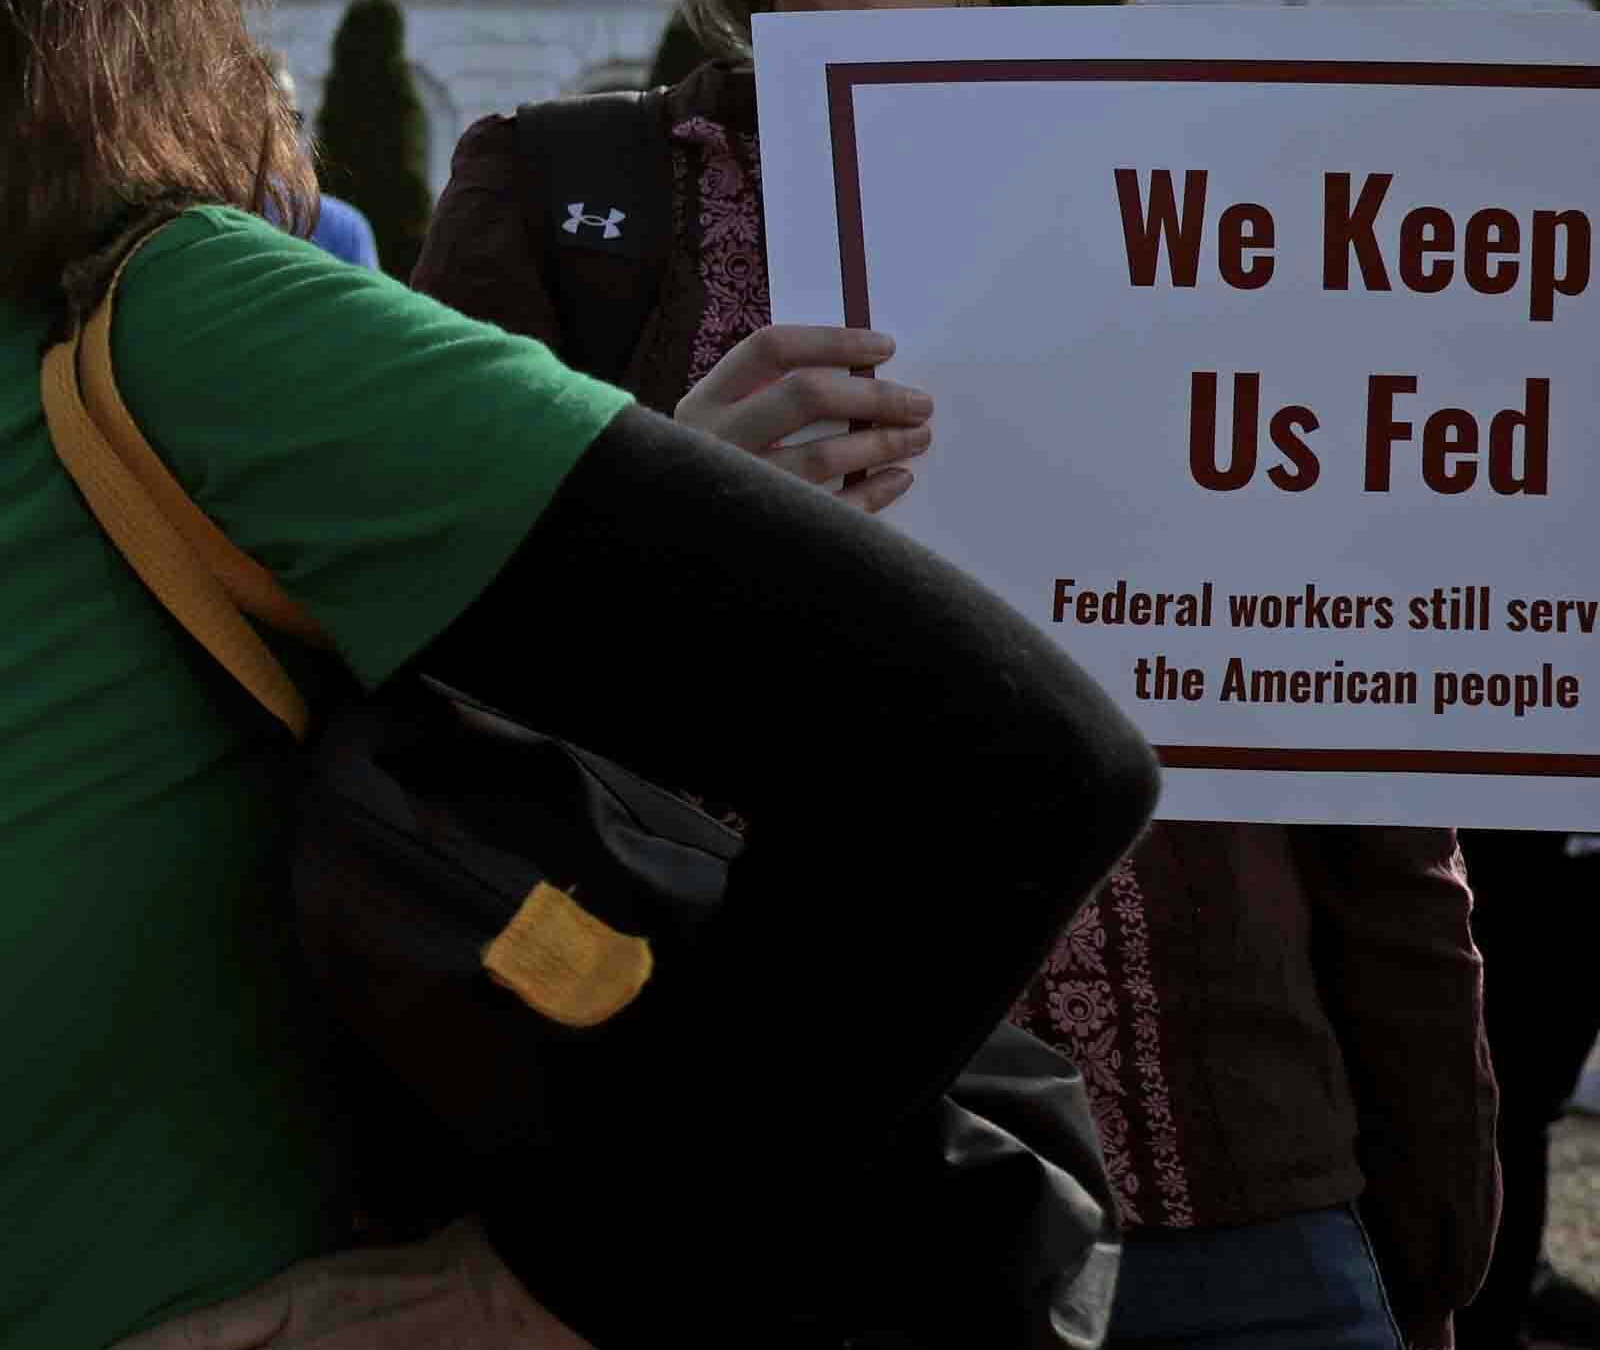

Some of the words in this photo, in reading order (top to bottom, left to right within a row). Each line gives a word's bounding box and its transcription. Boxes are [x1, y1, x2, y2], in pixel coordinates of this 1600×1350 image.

[1113, 168, 1276, 291] We
[1322, 171, 1592, 323] Keep
[1189, 371, 1321, 493] Us
[1363, 374, 1551, 496] Fed
[1052, 578, 1213, 627] Federal
[1228, 582, 1394, 630] workers
[1408, 585, 1491, 632] still
[1506, 599, 1599, 634] serv
[1133, 655, 1205, 702] the
[1219, 657, 1417, 705] American
[1434, 662, 1580, 717] people
